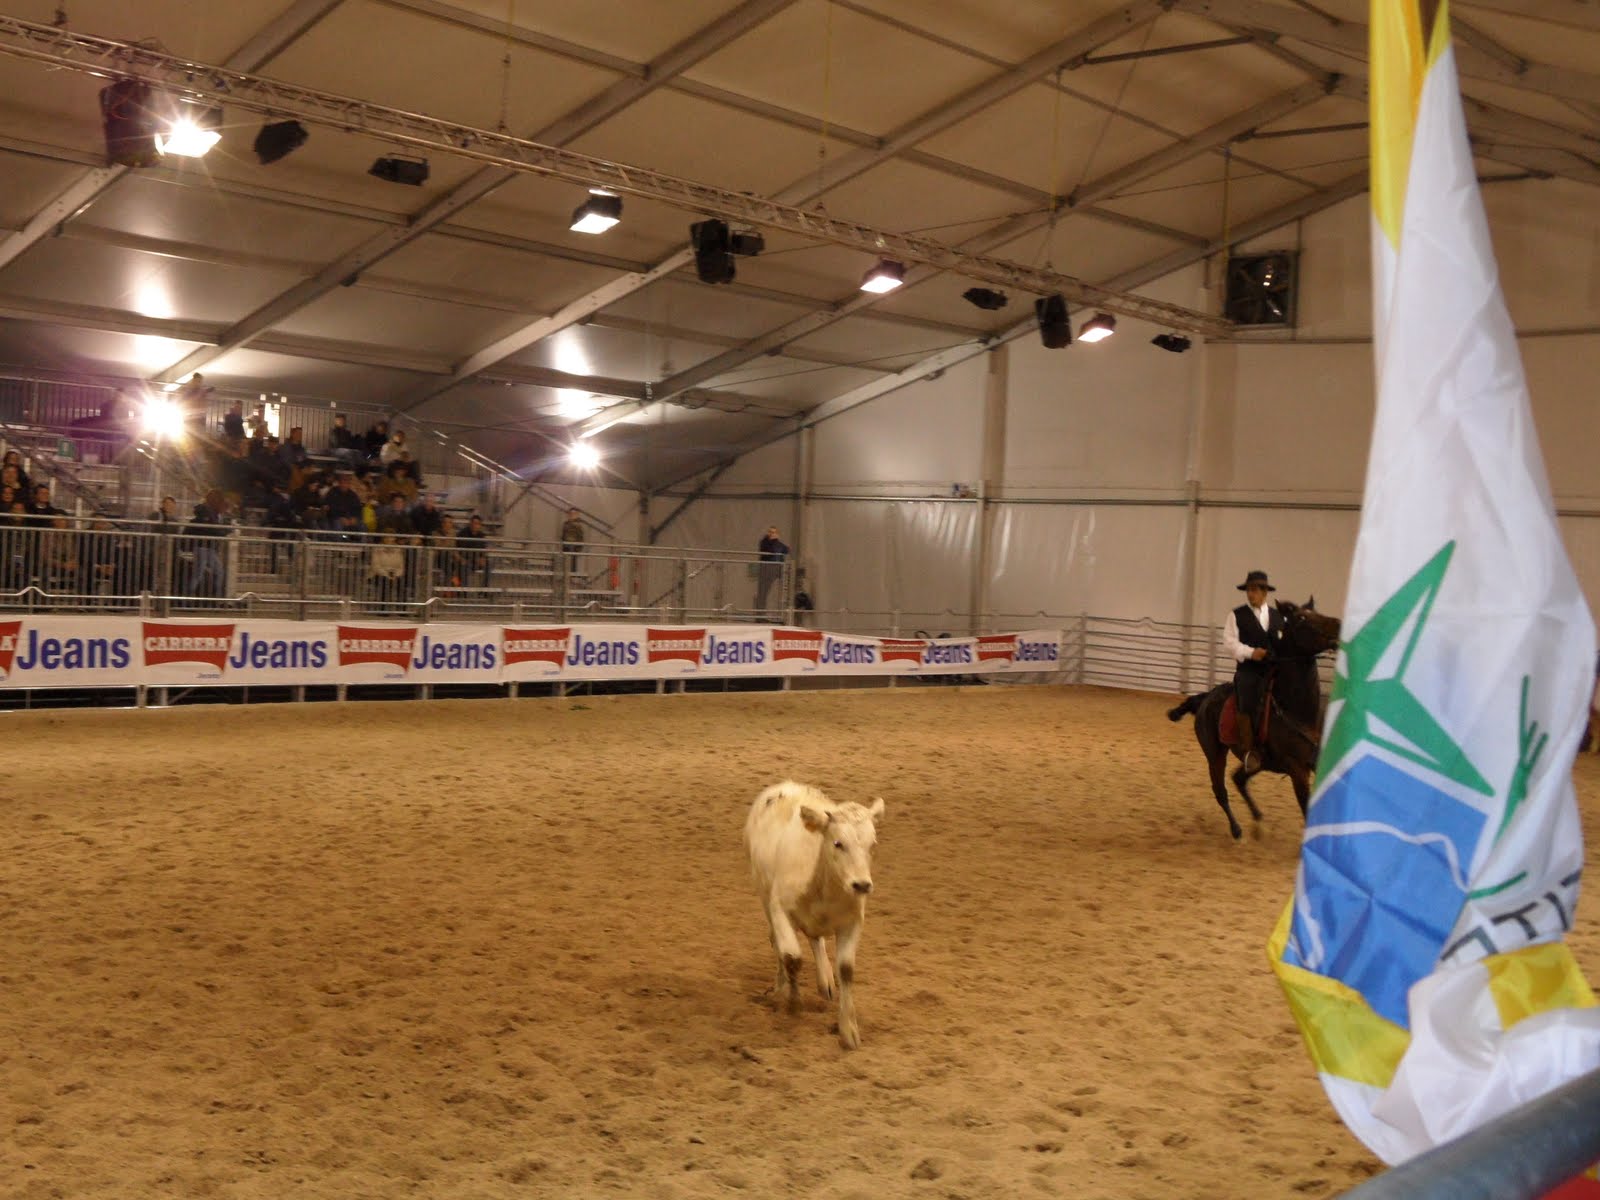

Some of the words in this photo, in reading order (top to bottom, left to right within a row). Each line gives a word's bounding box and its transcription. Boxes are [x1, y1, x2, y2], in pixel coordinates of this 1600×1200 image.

[16, 630, 130, 669] Jeans
[144, 636, 229, 652] CARRERA
[230, 632, 327, 668] Jeans
[339, 639, 412, 653] CARRERA
[412, 635, 496, 669] Jeans
[567, 635, 639, 666] Jeans
[702, 634, 765, 664] Jeans
[820, 636, 874, 664] Jeans
[923, 641, 972, 663] Jeans
[1014, 638, 1058, 661] Jeans
